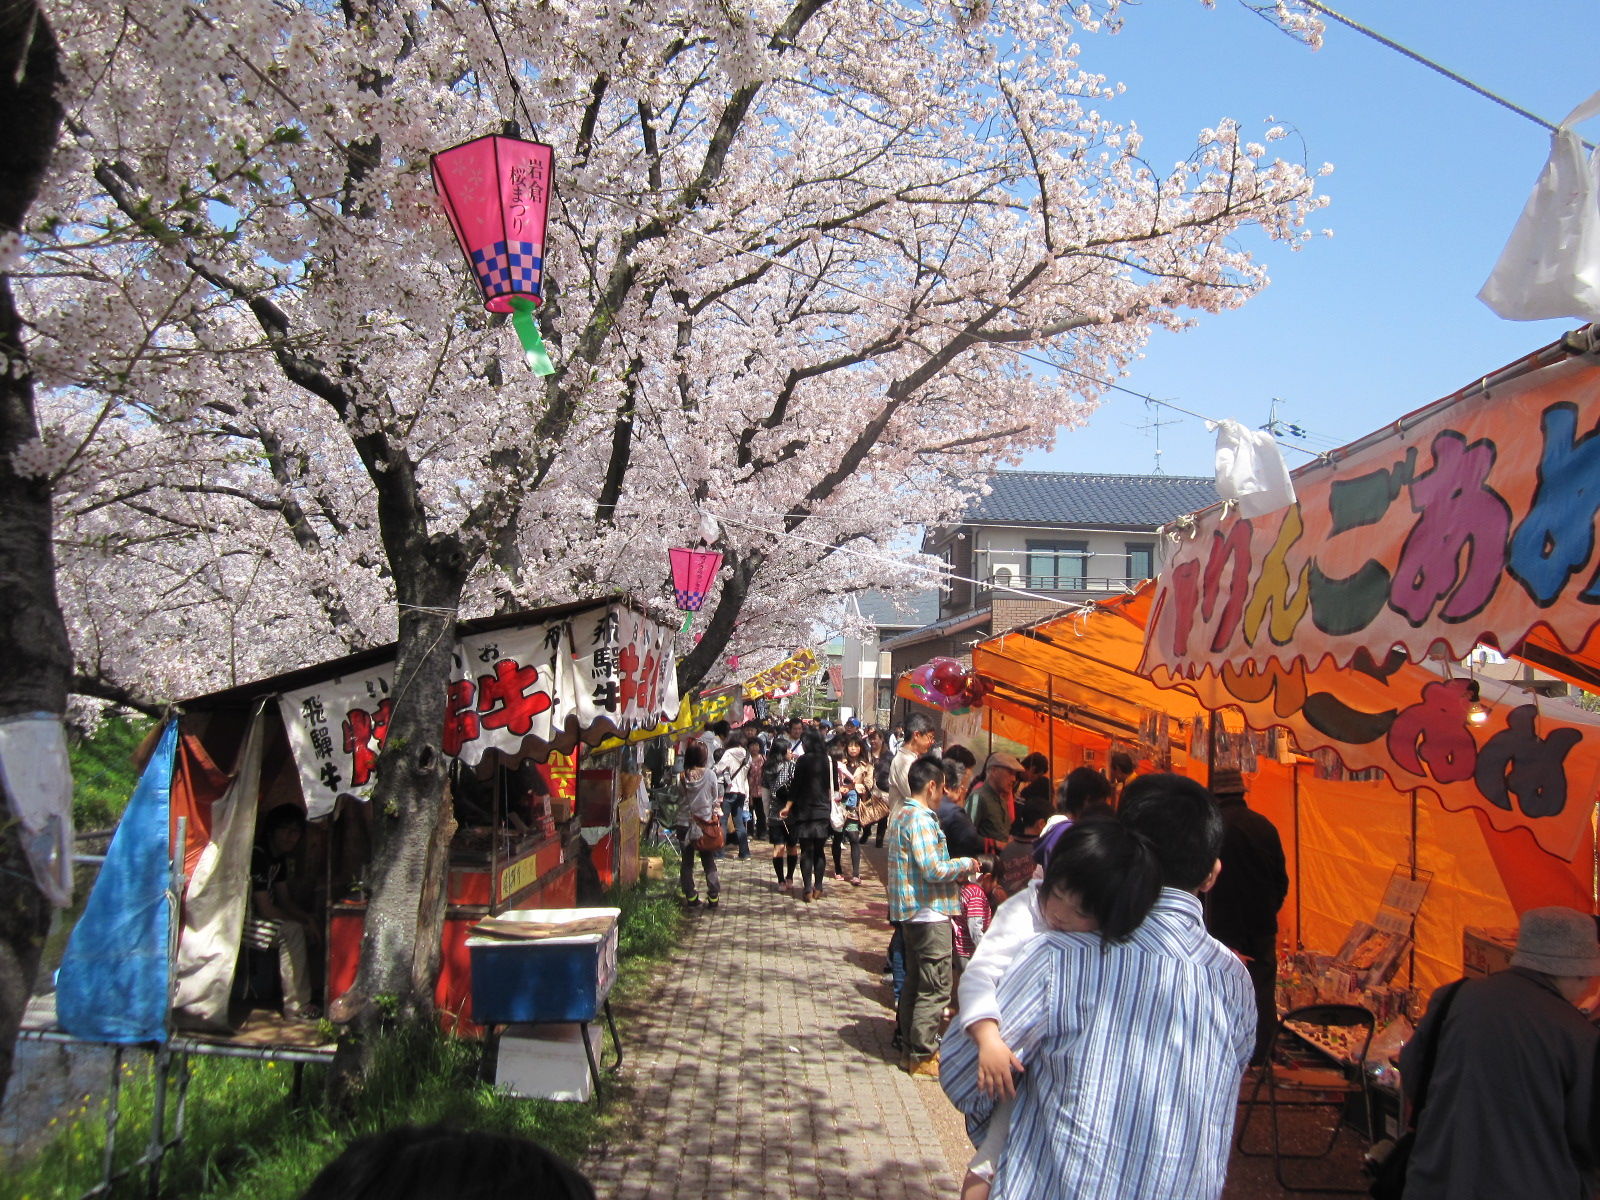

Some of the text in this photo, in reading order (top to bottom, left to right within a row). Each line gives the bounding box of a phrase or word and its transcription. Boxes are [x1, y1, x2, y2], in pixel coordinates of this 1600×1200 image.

[509, 165, 527, 235] 桜まつり
[528, 158, 543, 204] 岩倉
